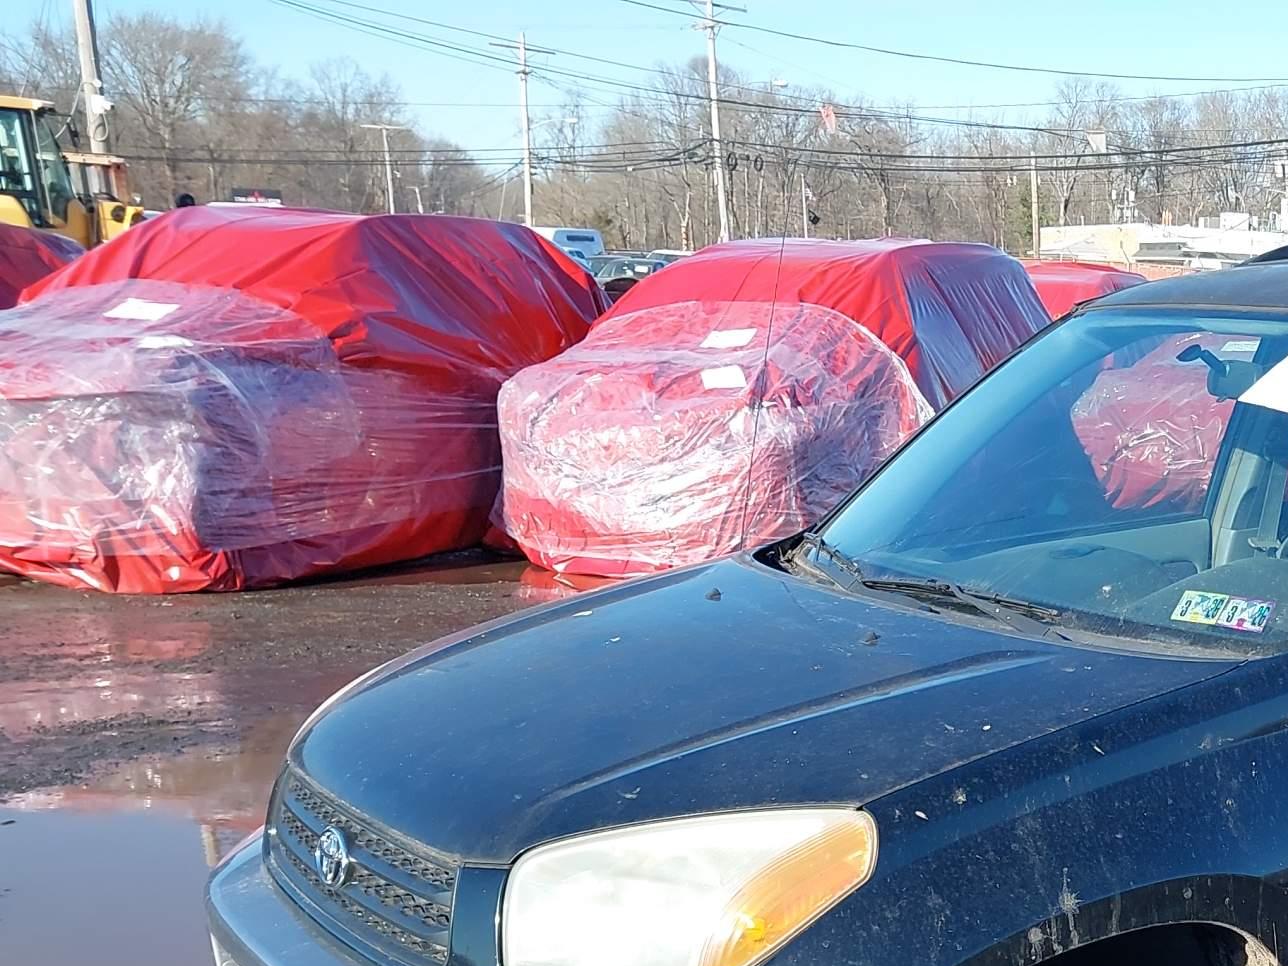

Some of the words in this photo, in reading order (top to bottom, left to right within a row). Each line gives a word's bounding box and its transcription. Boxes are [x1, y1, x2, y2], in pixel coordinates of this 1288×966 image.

[1180, 600, 1192, 617] 3
[1226, 605, 1238, 623] 3
[1251, 605, 1270, 627] 26
